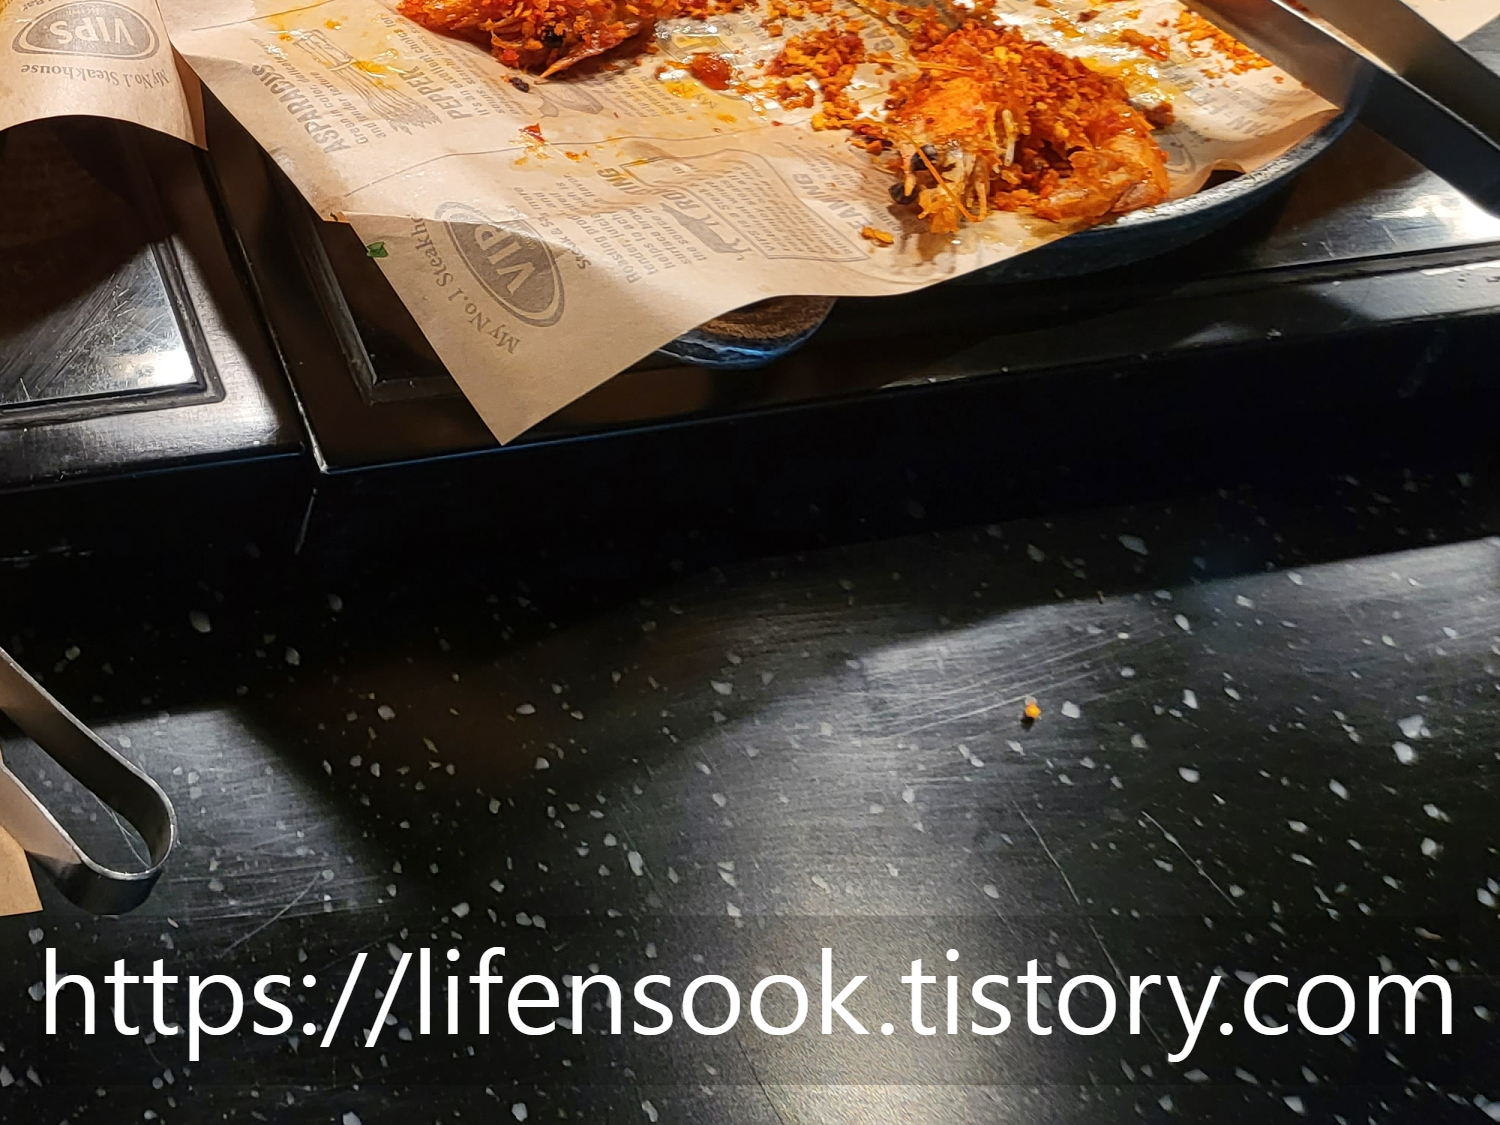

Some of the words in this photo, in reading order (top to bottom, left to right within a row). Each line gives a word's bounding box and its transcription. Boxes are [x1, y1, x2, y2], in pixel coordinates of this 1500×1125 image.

[48, 16, 137, 47] VIPS
[20, 58, 120, 86] Steakhouse
[337, 116, 368, 145] Green
[364, 121, 386, 140] and
[469, 211, 540, 296] VIP
[593, 234, 642, 282] Roasting
[447, 286, 488, 332] No.1
[487, 324, 521, 354] My
